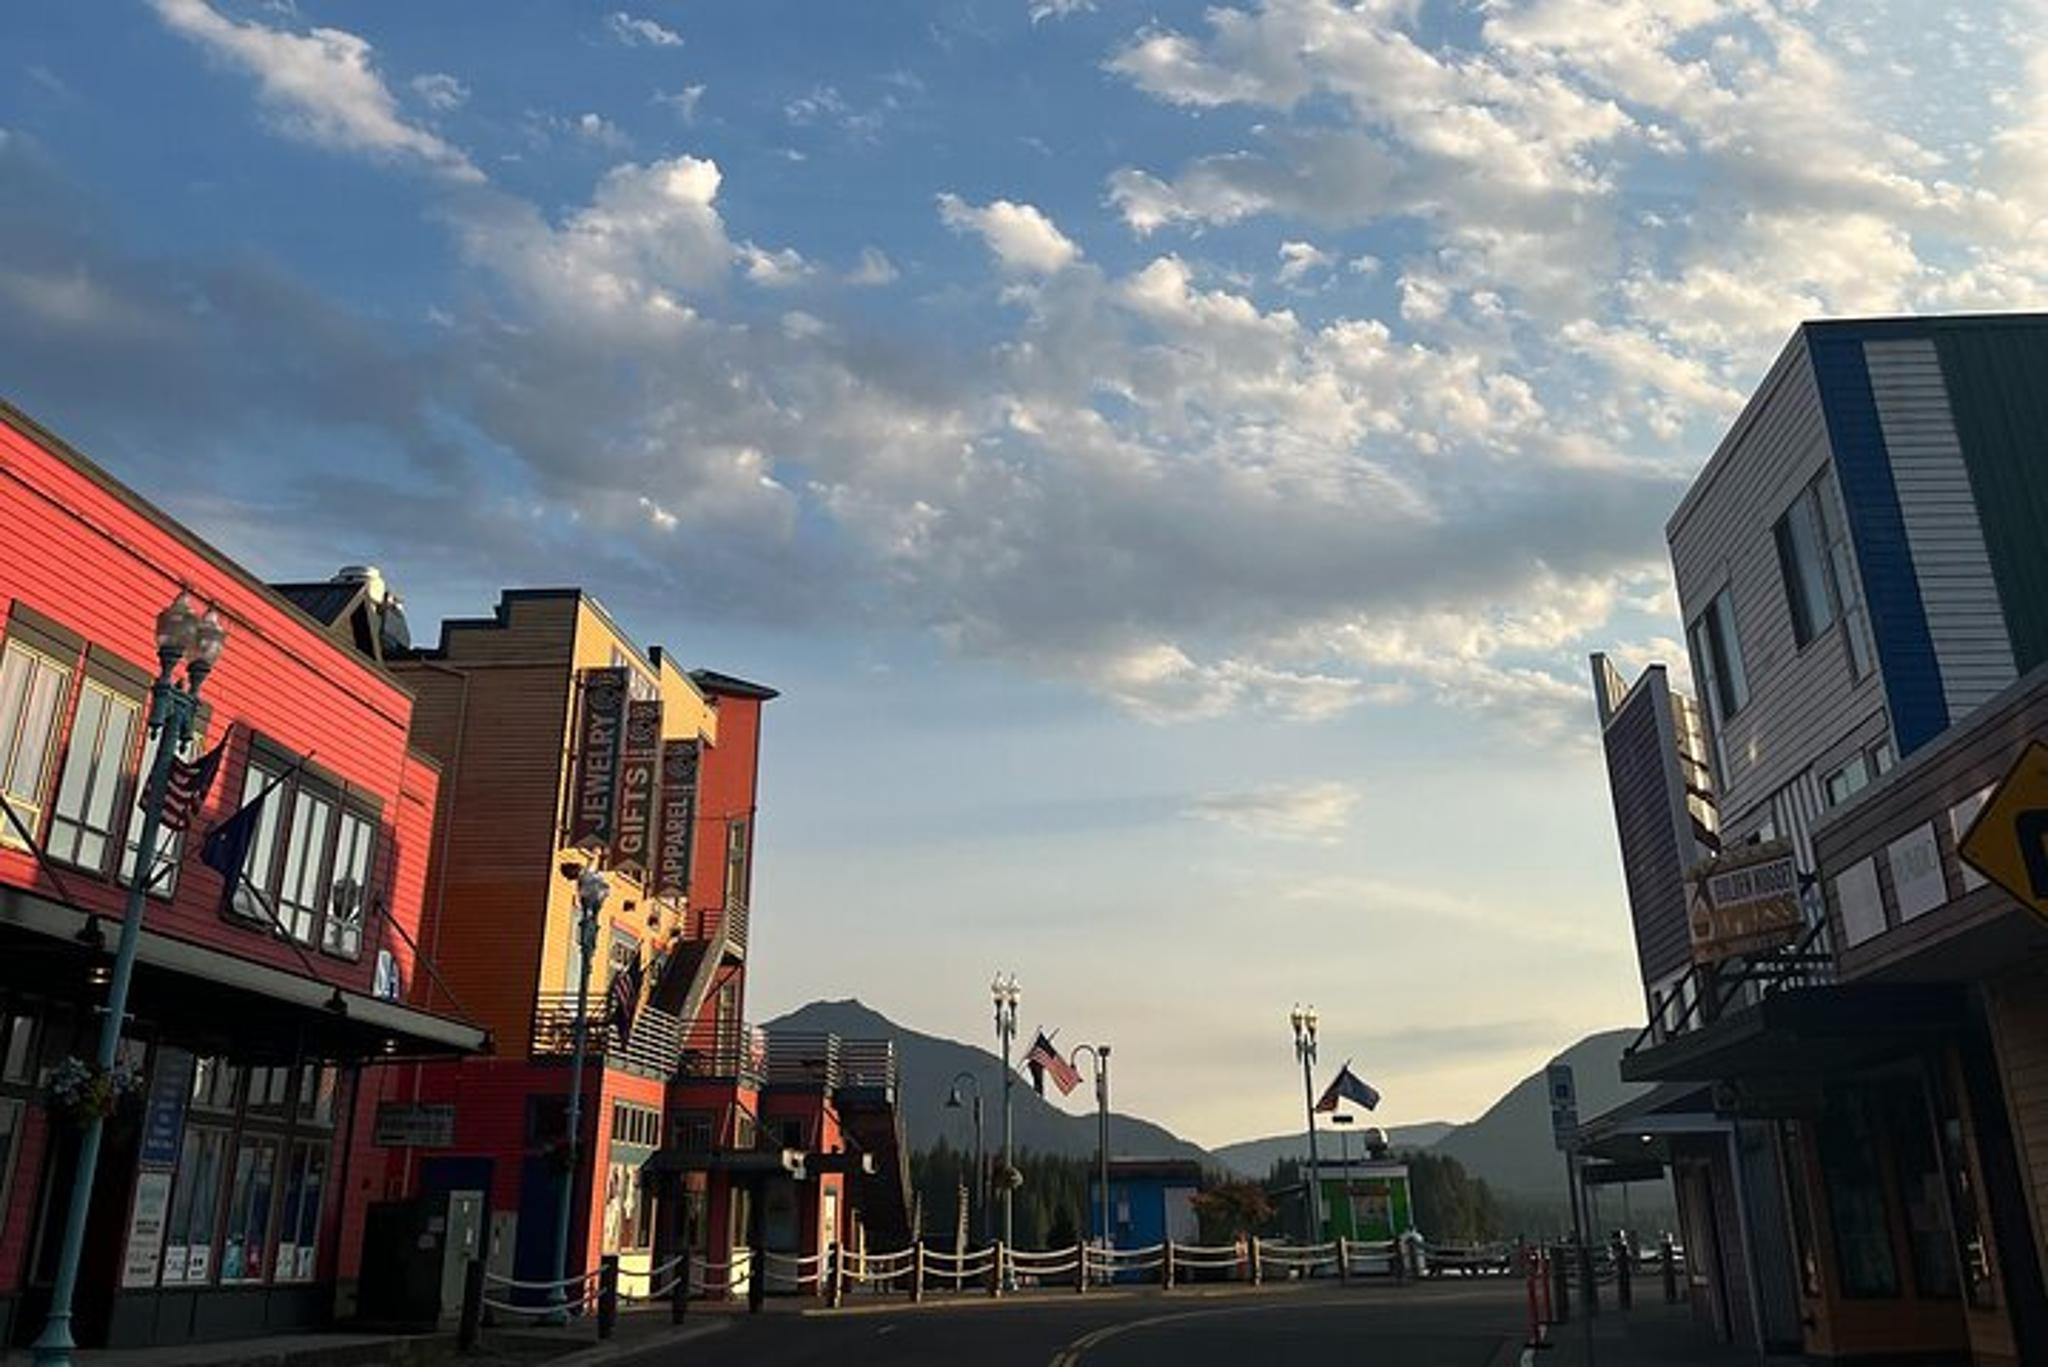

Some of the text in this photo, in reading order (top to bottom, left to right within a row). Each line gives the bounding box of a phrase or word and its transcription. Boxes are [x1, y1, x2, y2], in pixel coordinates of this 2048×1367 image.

[581, 714, 613, 830] JEWELRY
[620, 767, 648, 853] GIFTS
[663, 796, 689, 886] APPAREL
